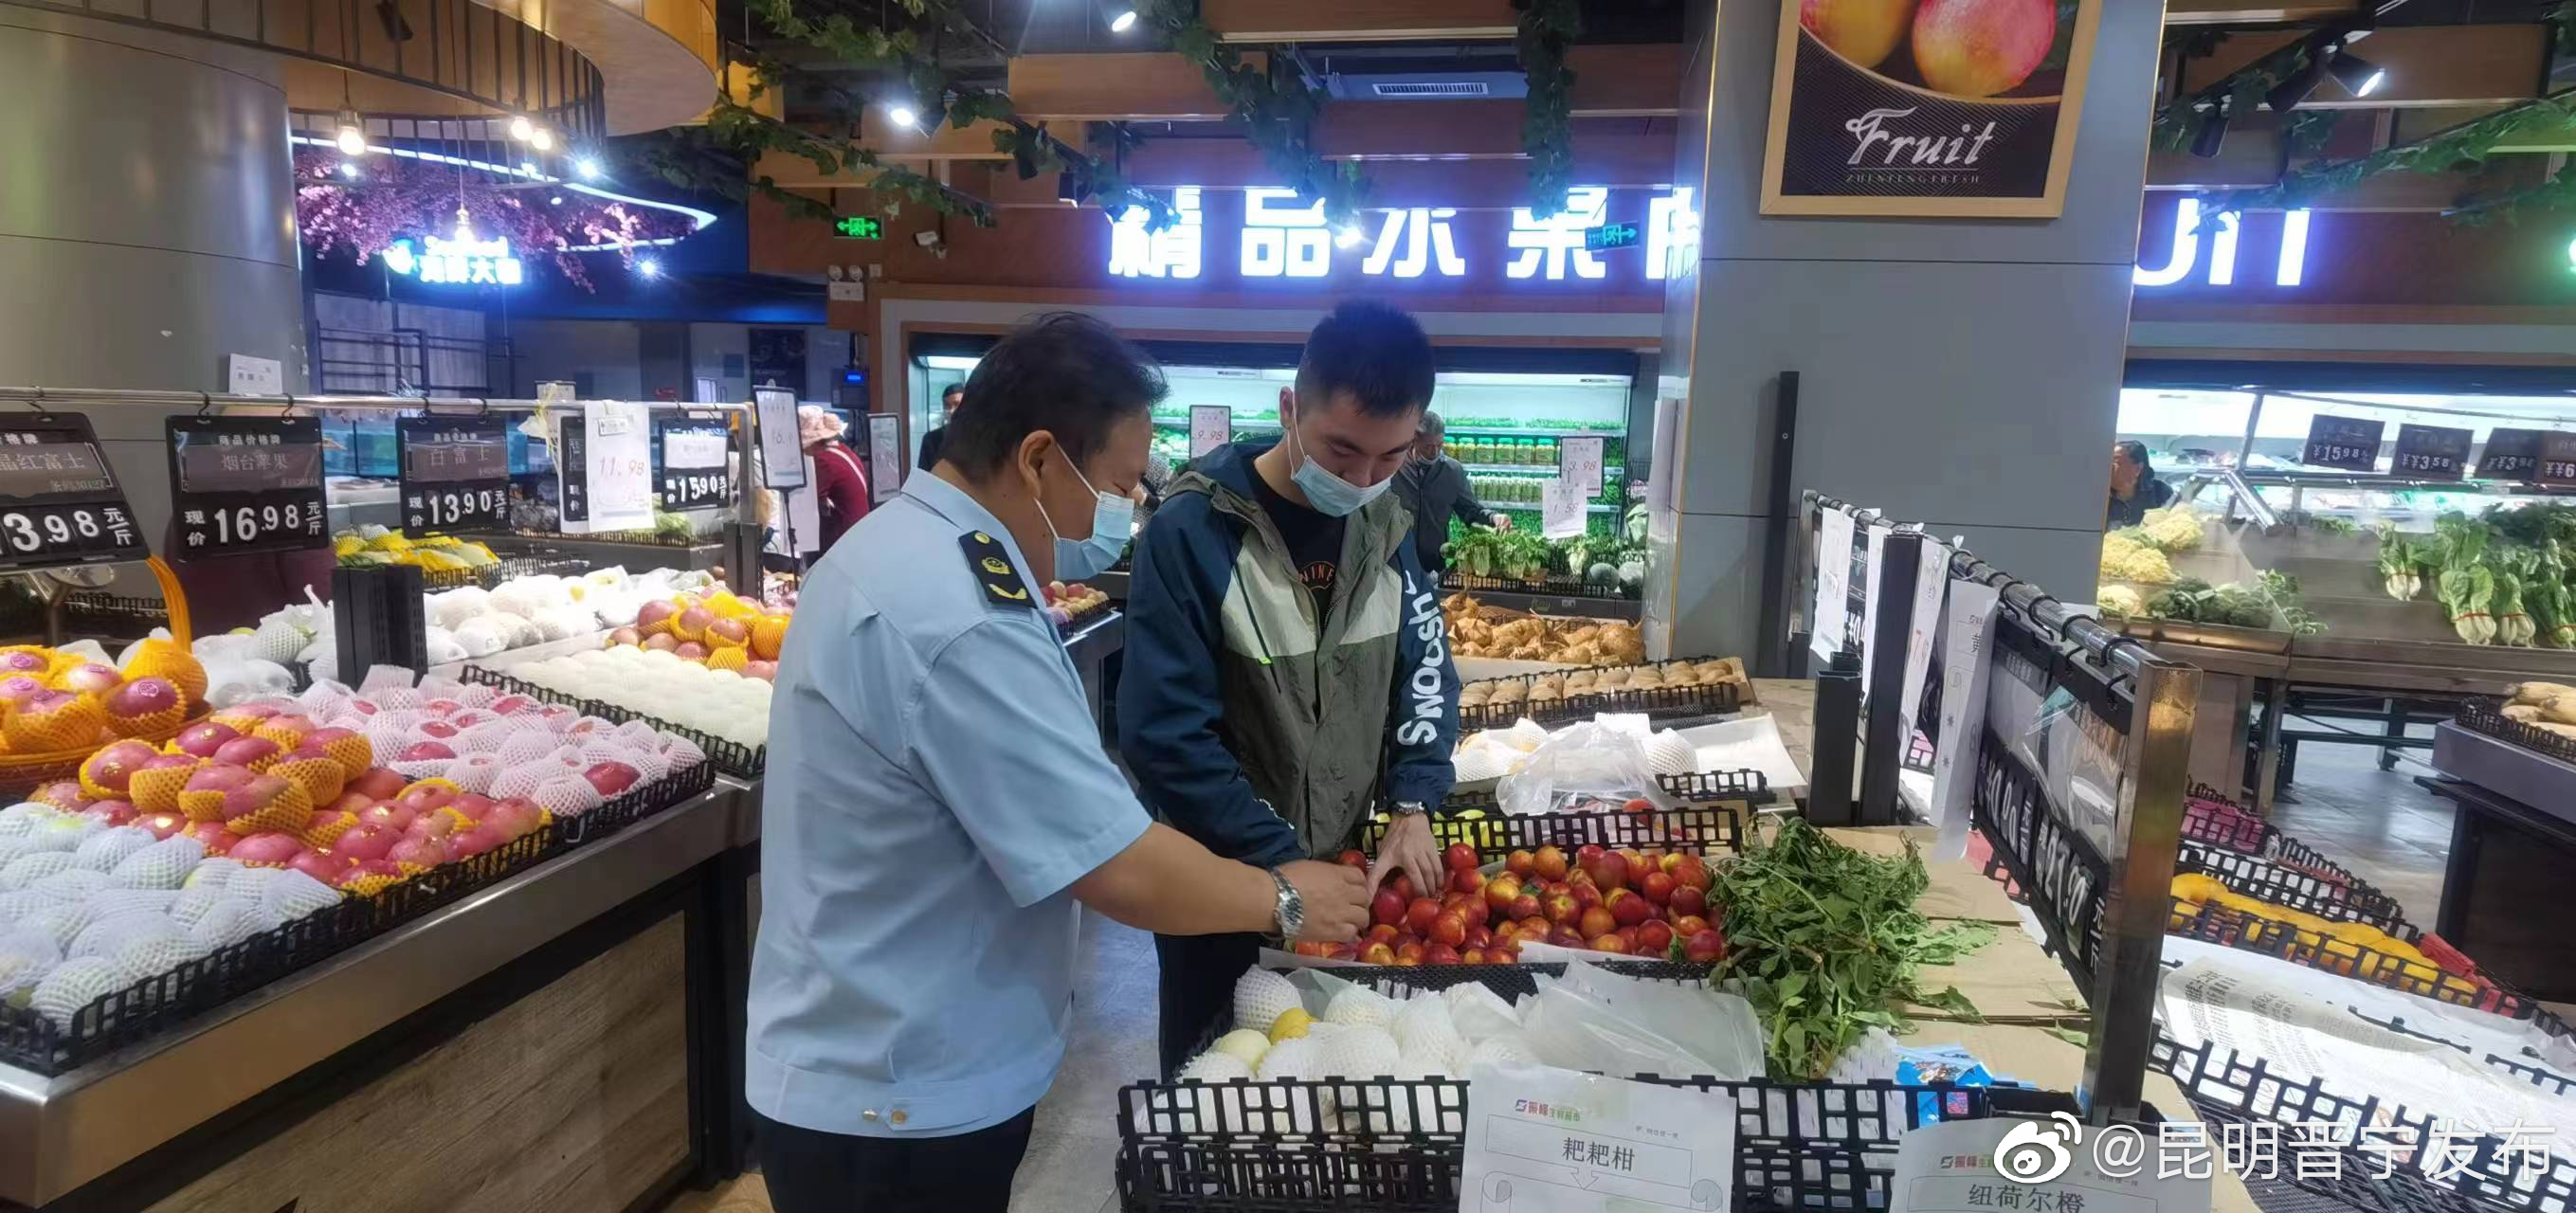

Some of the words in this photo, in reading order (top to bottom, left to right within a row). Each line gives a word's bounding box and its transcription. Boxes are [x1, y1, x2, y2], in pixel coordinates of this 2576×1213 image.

[1845, 106, 1995, 164] Fruit
[214, 504, 299, 543] 16.98
[305, 501, 323, 535] 元/斤
[409, 497, 424, 527] 现价
[429, 491, 491, 524] 13.90
[185, 510, 206, 547] 现价
[1968, 1184, 2085, 1213] 纽荷尔橙
